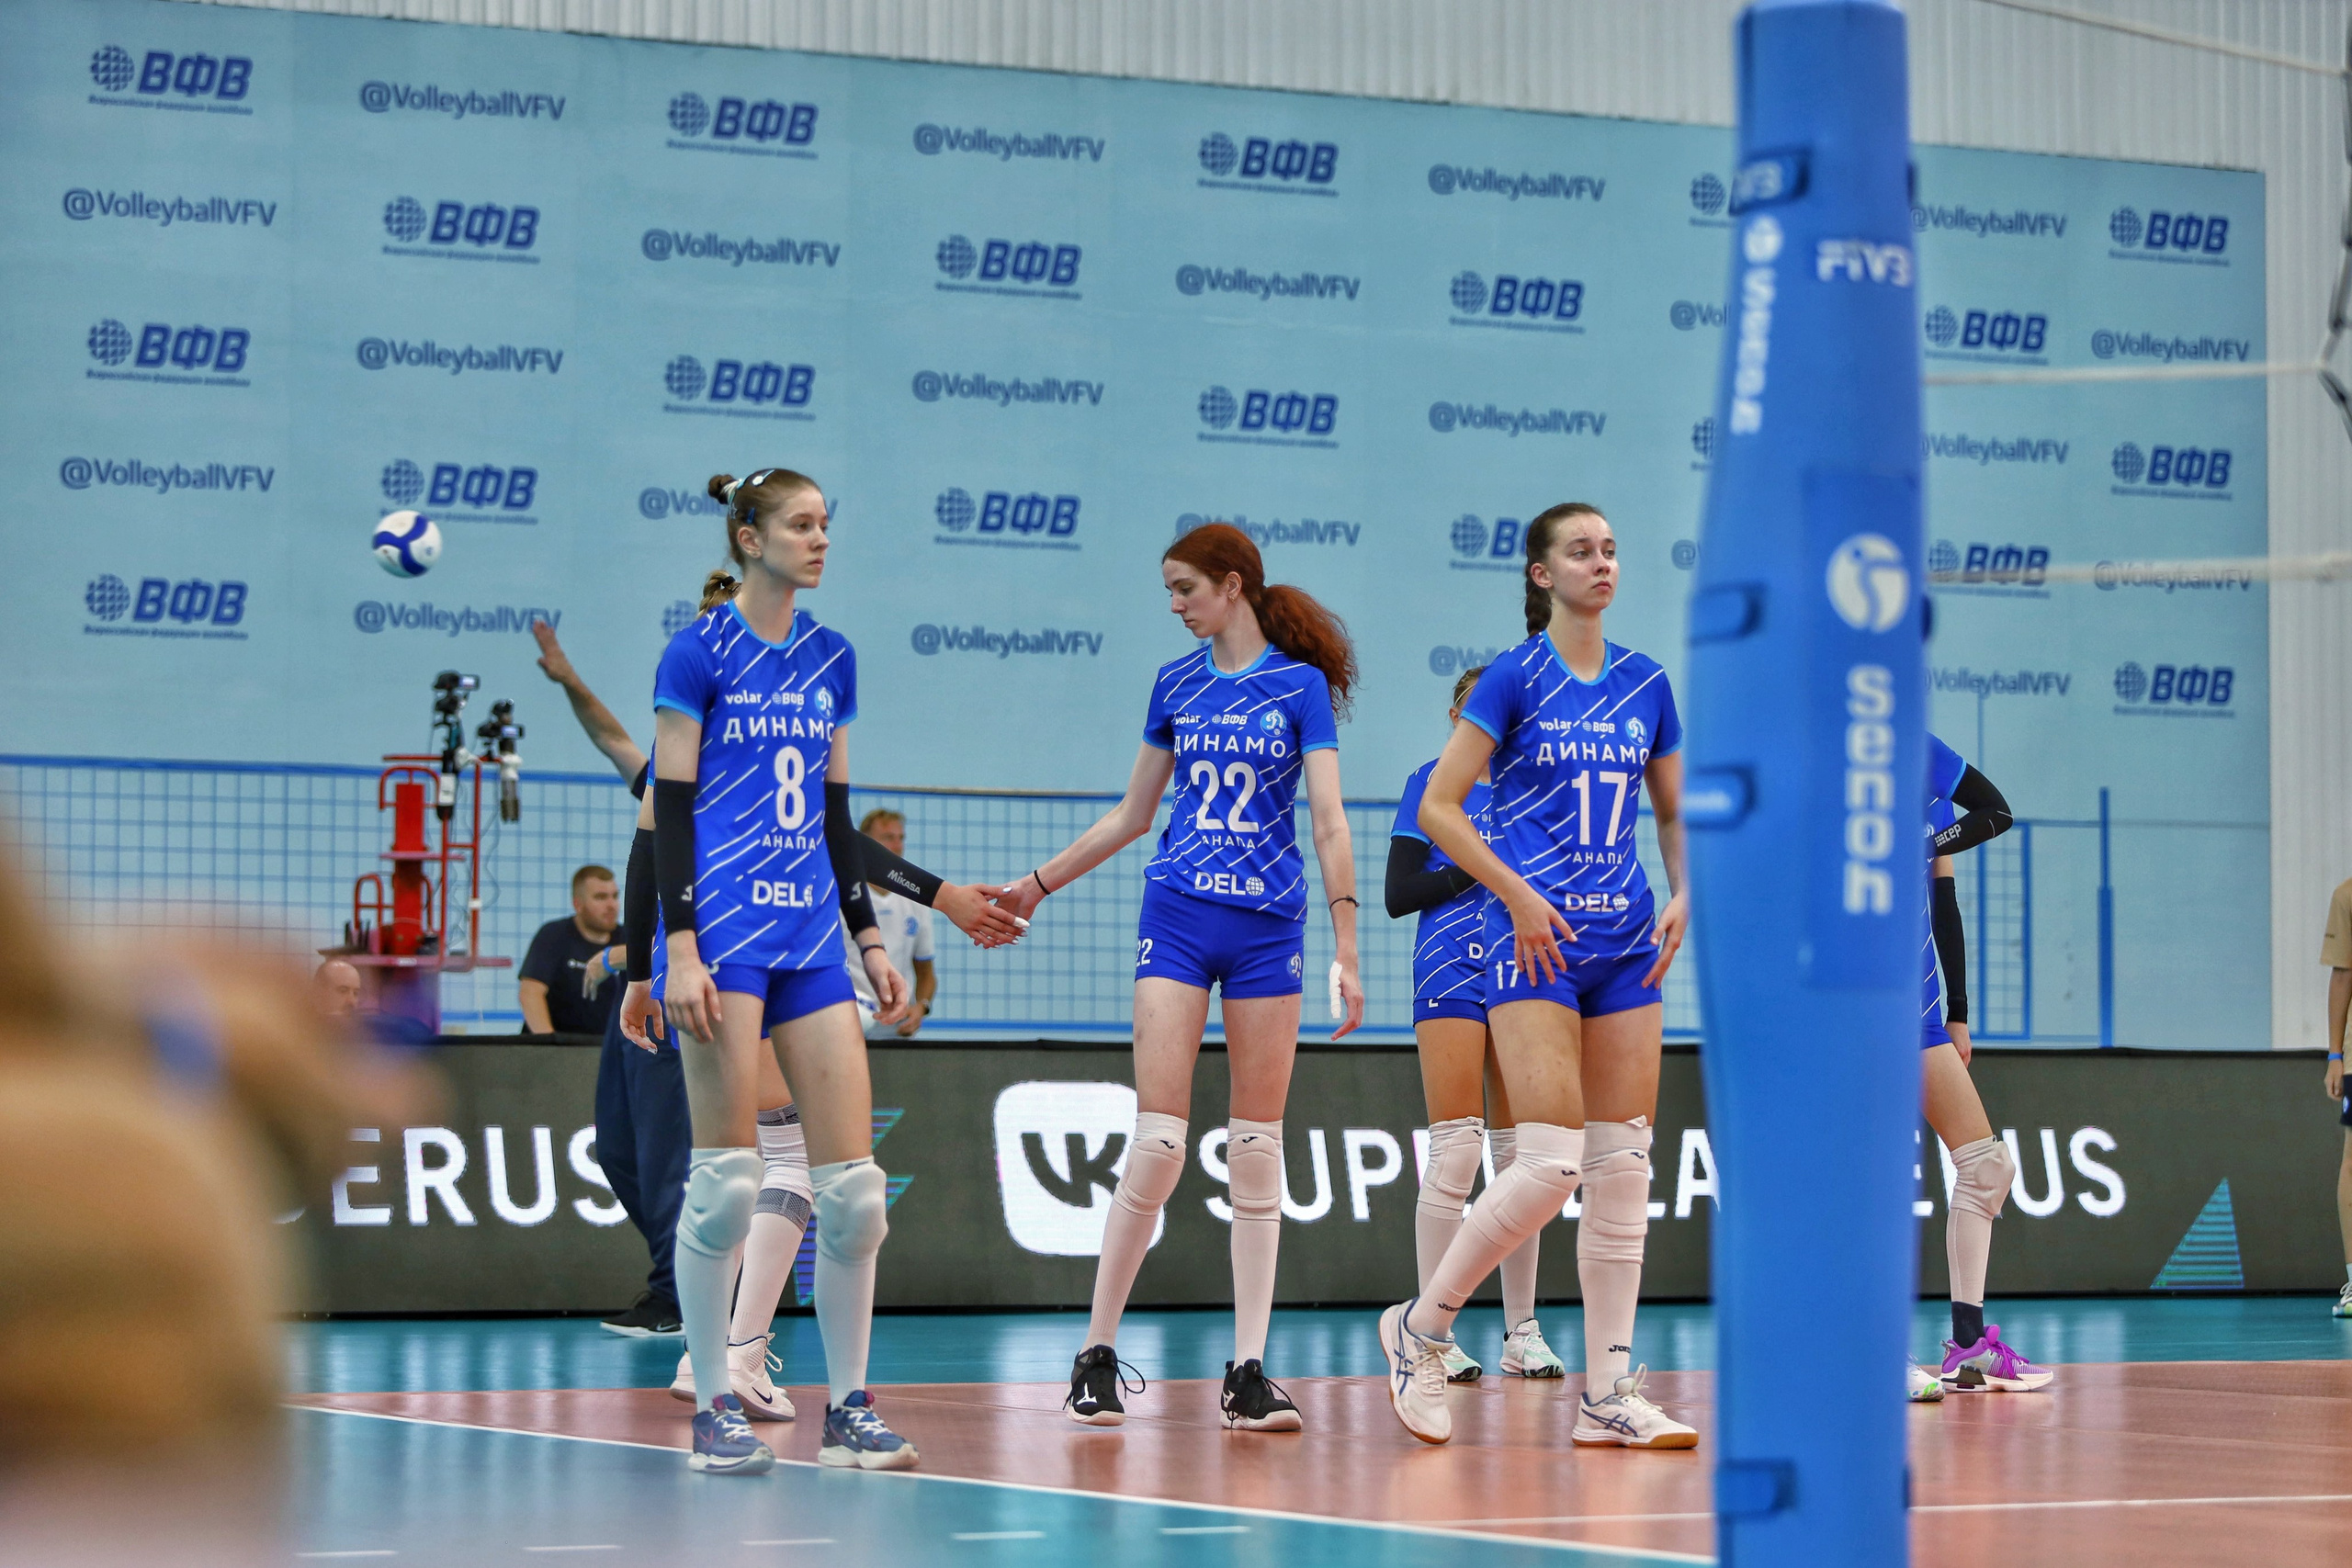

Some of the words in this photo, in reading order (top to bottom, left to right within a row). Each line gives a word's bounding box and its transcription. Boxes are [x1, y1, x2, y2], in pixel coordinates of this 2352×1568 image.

[138, 51, 254, 101] ВФВ
[360, 81, 565, 120] @VolleyballVFV
[713, 96, 818, 145] ВФВ
[913, 123, 1104, 162] @VolleyballVFV
[1239, 136, 1340, 185] ВФВ
[1428, 164, 1606, 202] @VolleyballVFV
[62, 188, 277, 227] @VolleyballVFV
[428, 201, 540, 251] ВФВ
[642, 229, 840, 267] @VolleyballVFV
[2144, 210, 2230, 254] ВФВ
[978, 239, 1082, 287] ВФВ
[1176, 264, 1360, 301] @VolleyballVFV
[1489, 275, 1585, 321] ВФВ
[136, 324, 251, 372] ВФВ
[1961, 310, 2048, 353] ВФВ
[2092, 329, 2250, 364] @VolleyballVFV
[357, 336, 563, 376] @VolleyballVFV
[708, 358, 816, 408] ВФВ
[912, 369, 1103, 408] @VolleyballVFV
[1239, 389, 1340, 435] ВФВ
[1429, 400, 1606, 438] @VolleyballVFV
[60, 457, 274, 493] @VolleyballVFV
[426, 463, 538, 511] ВФВ
[2147, 444, 2233, 491] ВФВ
[978, 490, 1082, 538] ВФВ
[133, 578, 248, 626] ВФВ
[911, 623, 1102, 660] @VolleyballVFV
[725, 690, 763, 705] volar
[1928, 667, 2071, 699] VolleyballVFV
[2148, 663, 2234, 705] ВФВ
[1222, 714, 1249, 726] ВФВ
[1539, 717, 1573, 731] volar
[1174, 733, 1286, 759] ДИНАМО
[1536, 741, 1649, 766] ДИНАМО
[774, 745, 807, 830] 8
[1190, 760, 1260, 833] 22
[1571, 770, 1628, 847] 17
[762, 834, 817, 851] АНАПА
[1202, 835, 1256, 850] АНАПА
[1573, 852, 1623, 865] АНАПА
[888, 869, 921, 895] MIKASA
[1496, 960, 1520, 990] 17
